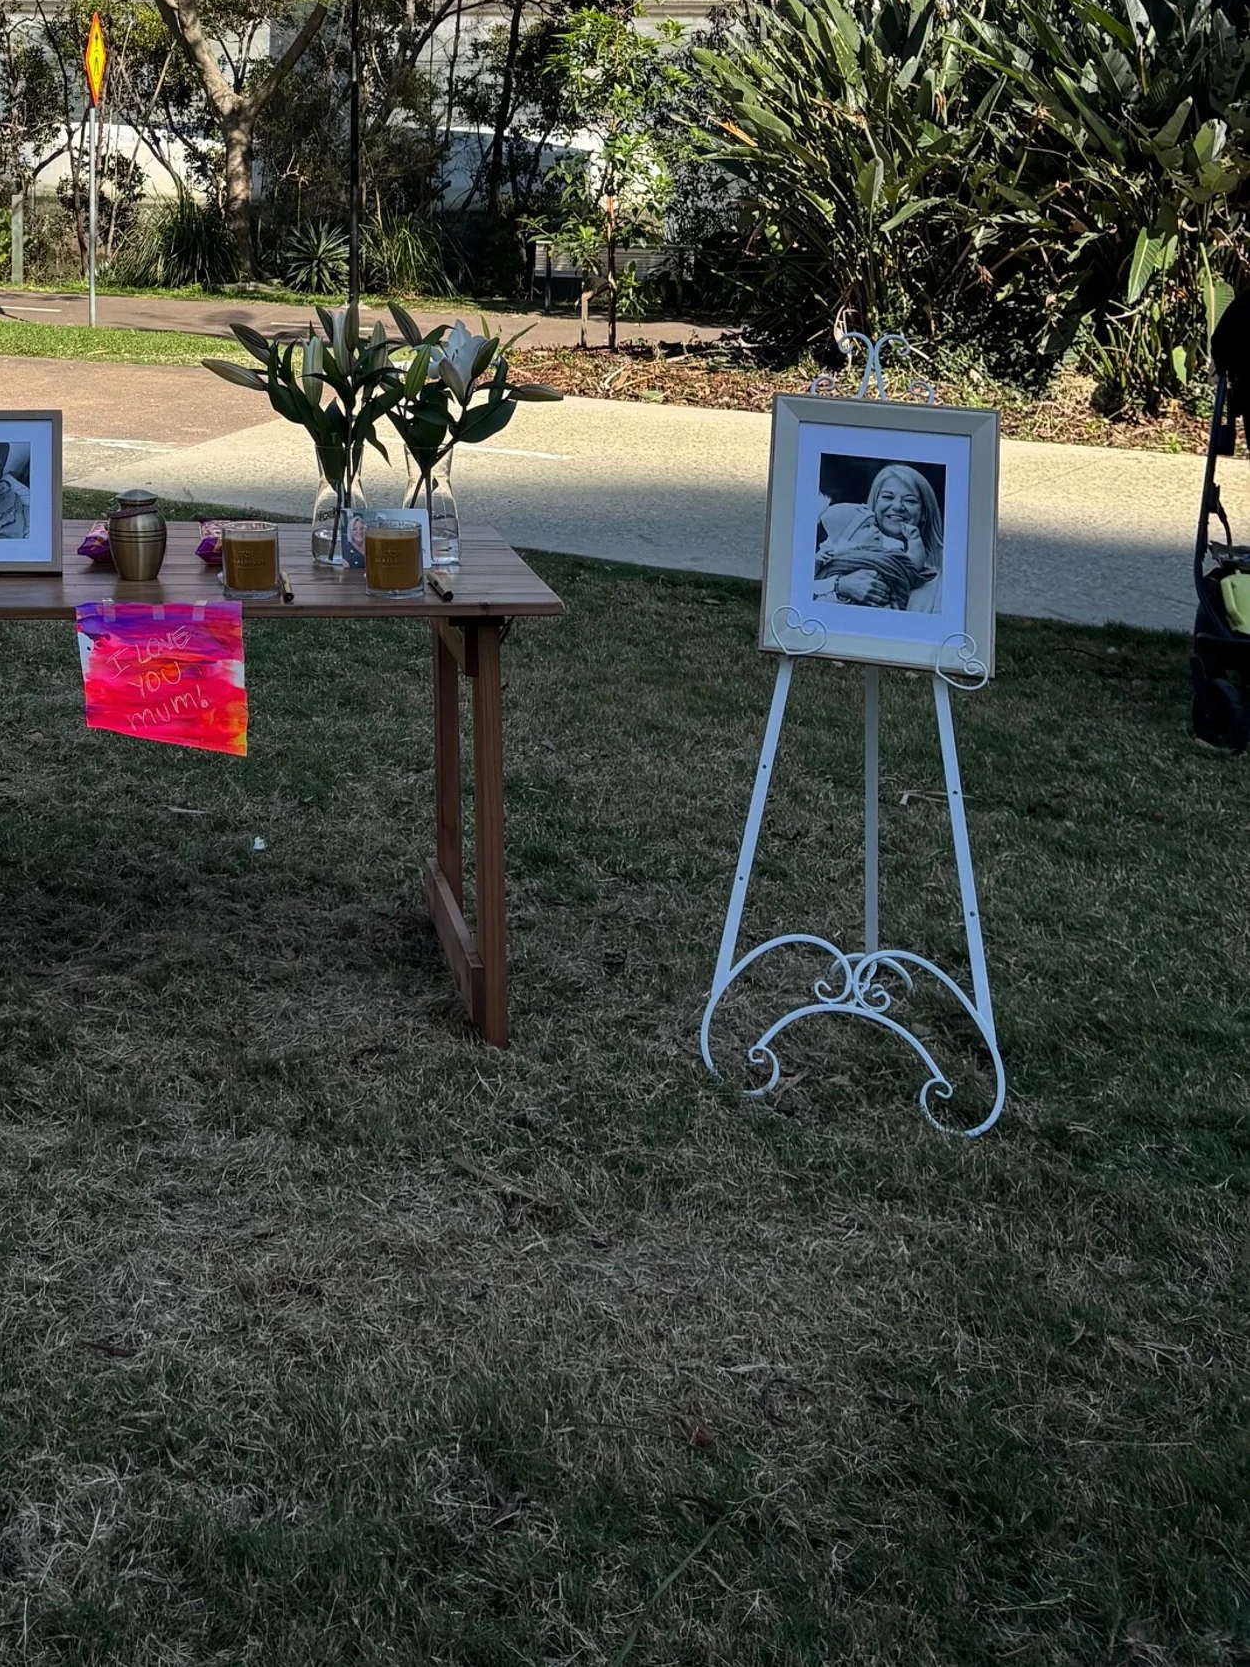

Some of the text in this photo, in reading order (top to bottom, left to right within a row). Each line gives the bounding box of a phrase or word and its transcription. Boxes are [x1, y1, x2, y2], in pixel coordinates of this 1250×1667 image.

[106, 625, 192, 680] I LOVE
[128, 661, 182, 699] YOU
